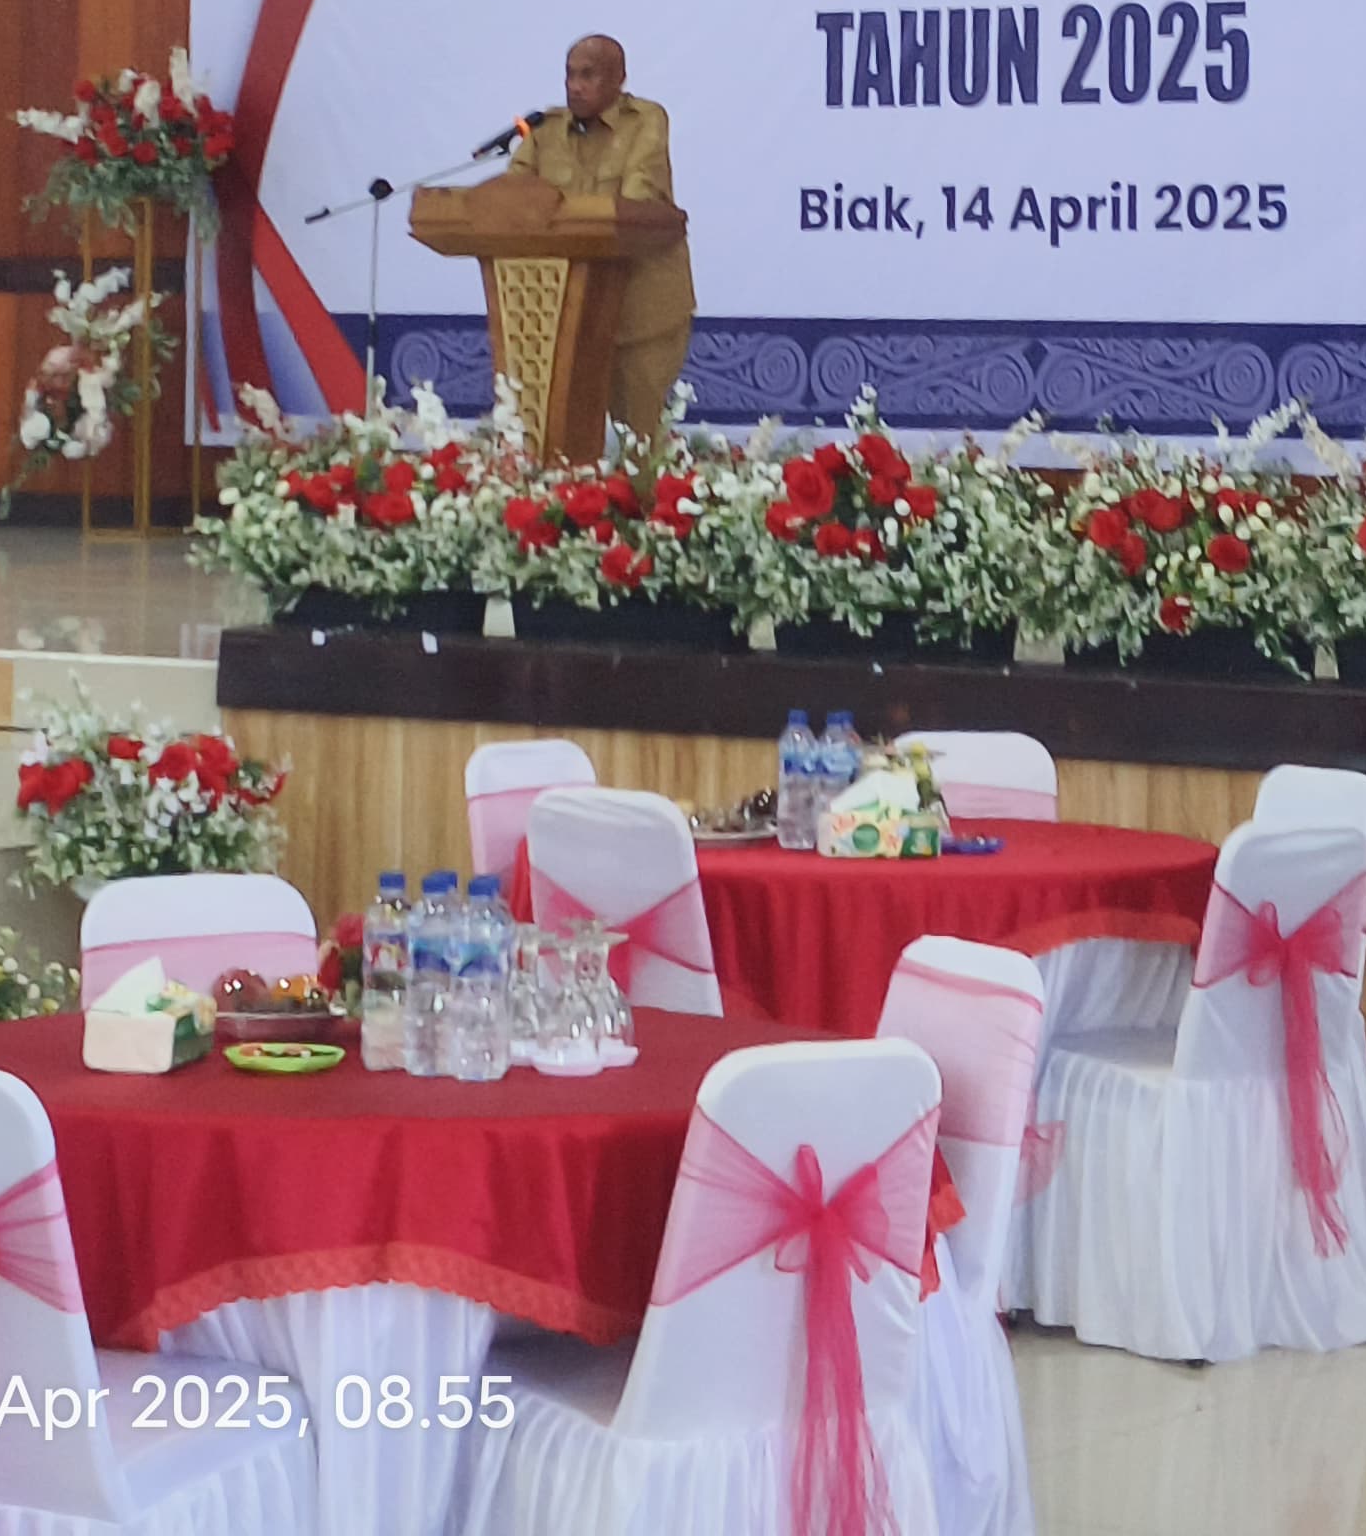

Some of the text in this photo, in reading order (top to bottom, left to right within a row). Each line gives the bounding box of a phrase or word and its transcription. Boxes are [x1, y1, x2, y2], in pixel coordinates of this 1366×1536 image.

[816, 2, 1249, 107] TAHUN 2025
[801, 184, 1287, 248] Biak, 14 April 2025
